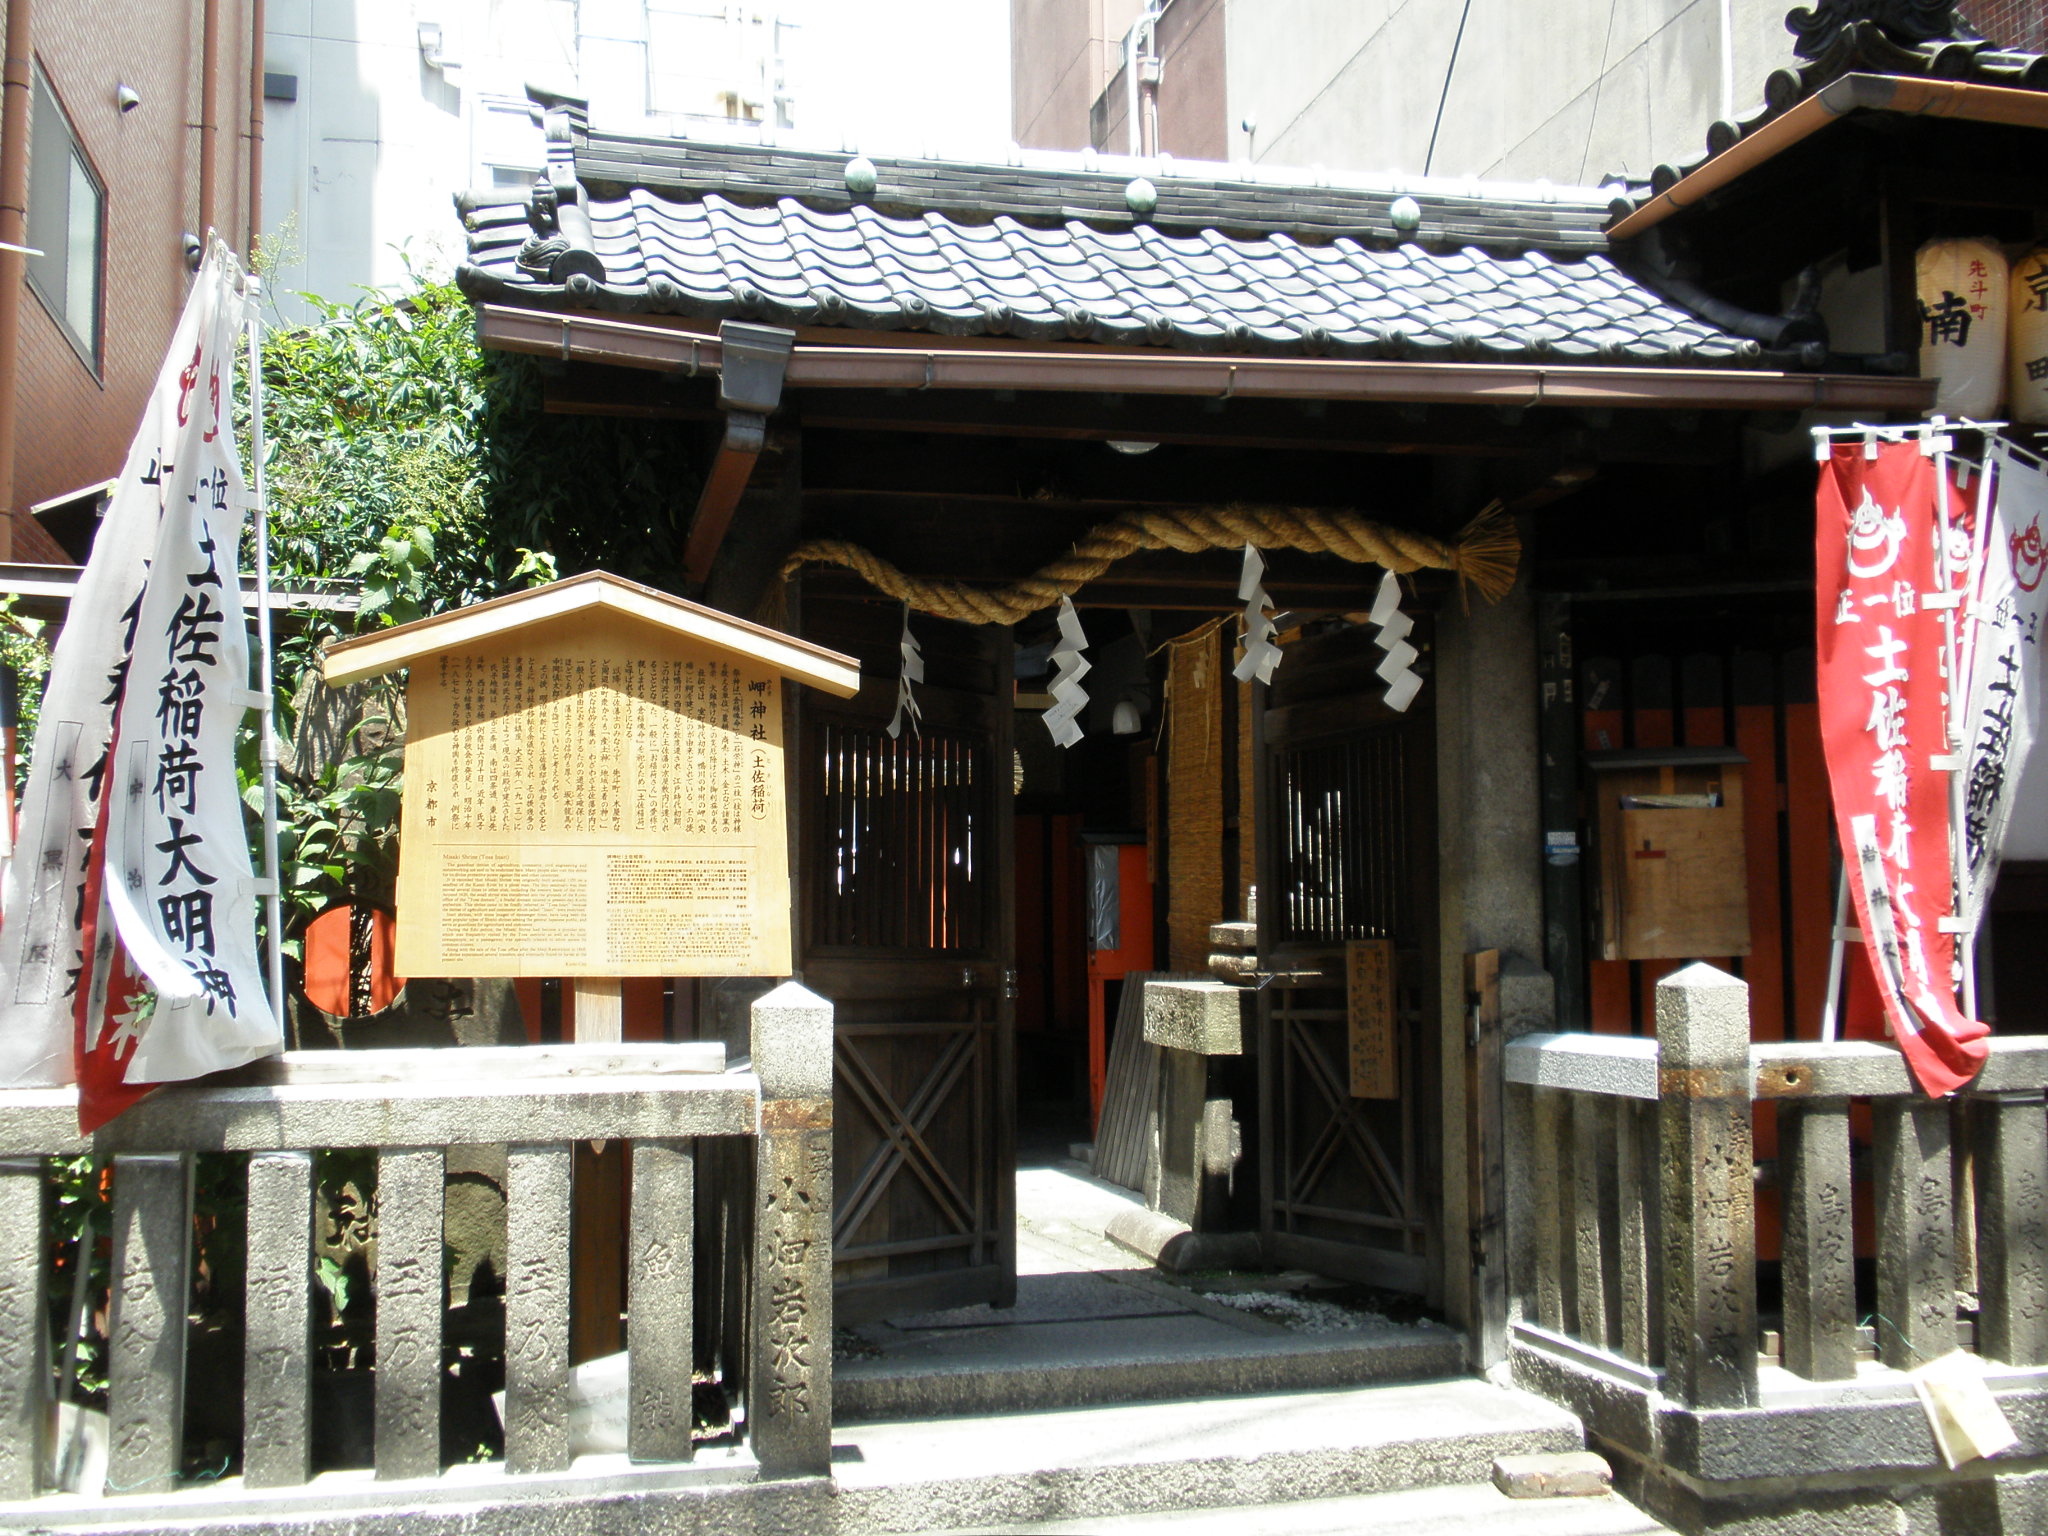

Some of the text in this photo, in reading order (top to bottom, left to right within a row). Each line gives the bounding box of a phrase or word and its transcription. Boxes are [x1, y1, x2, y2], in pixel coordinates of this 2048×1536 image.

[1968, 259, 1989, 320] 先斗町
[1835, 580, 1915, 625] 正一位
[152, 519, 237, 1019] 土佐稲荷大明神
[426, 780, 438, 829] 京都市
